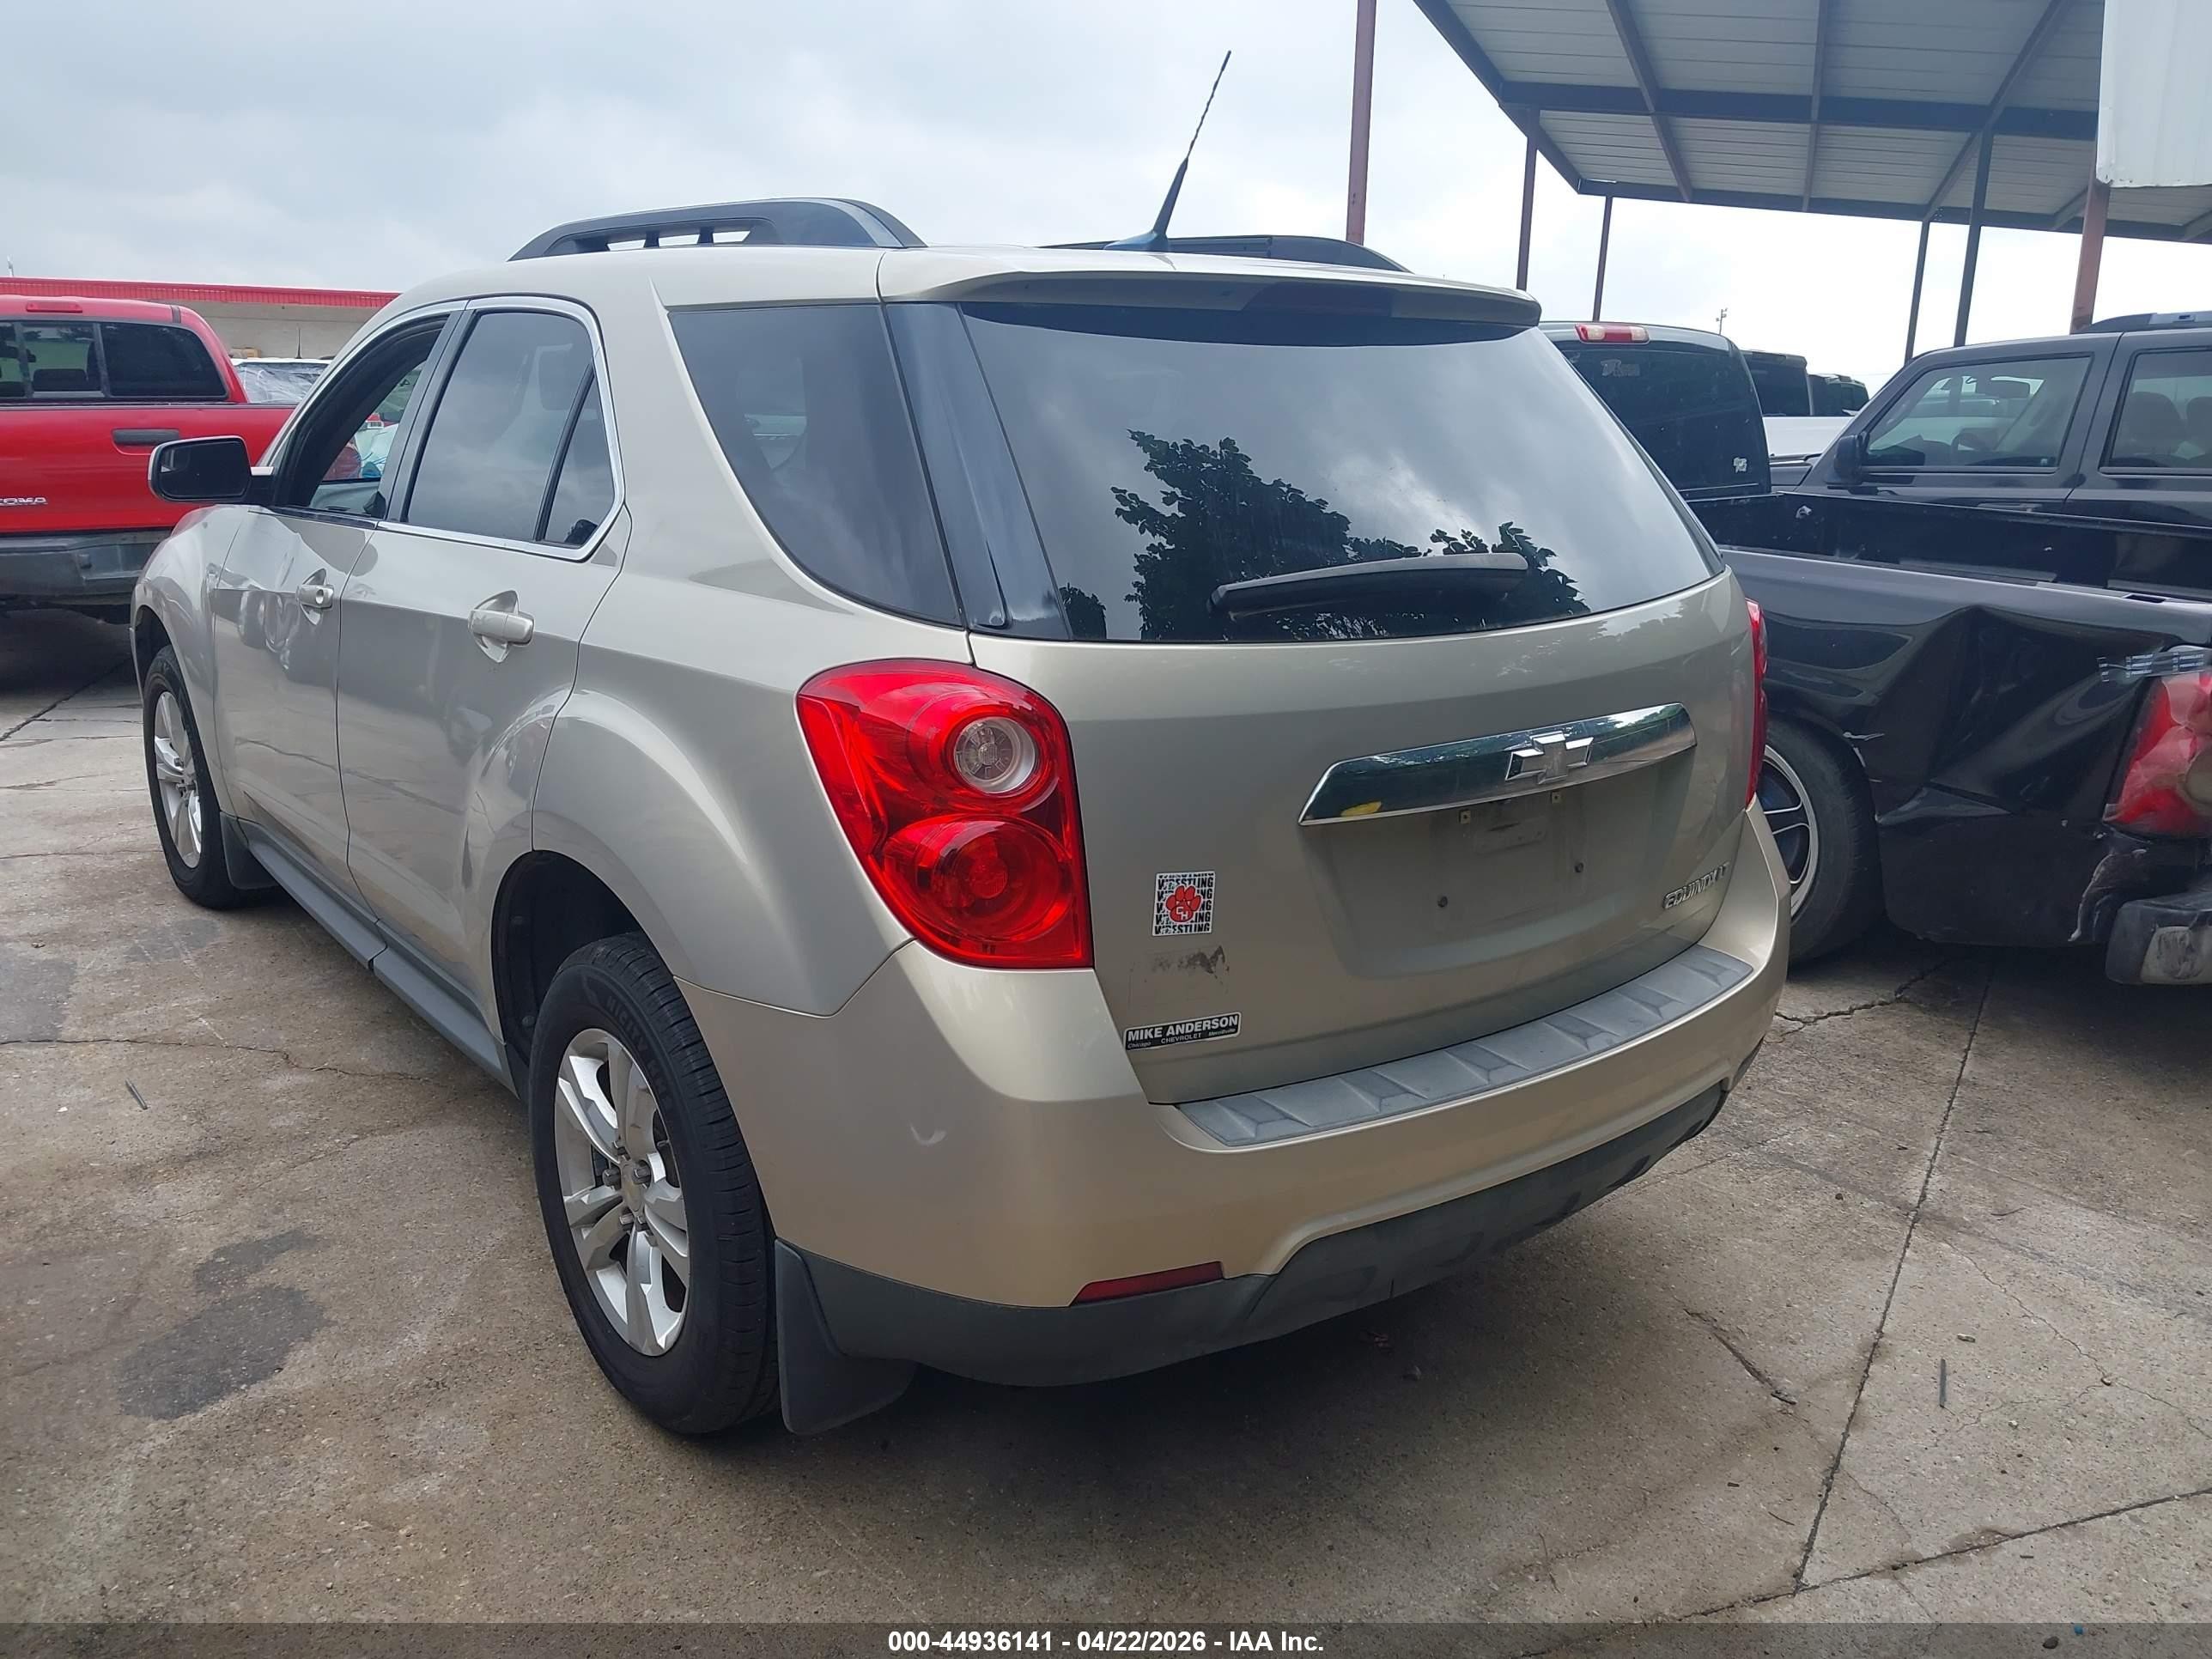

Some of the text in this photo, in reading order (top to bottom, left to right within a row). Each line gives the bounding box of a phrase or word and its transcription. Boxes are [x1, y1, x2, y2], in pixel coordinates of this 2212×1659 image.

[1127, 1015, 1238, 1042] MIKE ANDERSON
[1160, 1032, 1202, 1044] CHEVROLET
